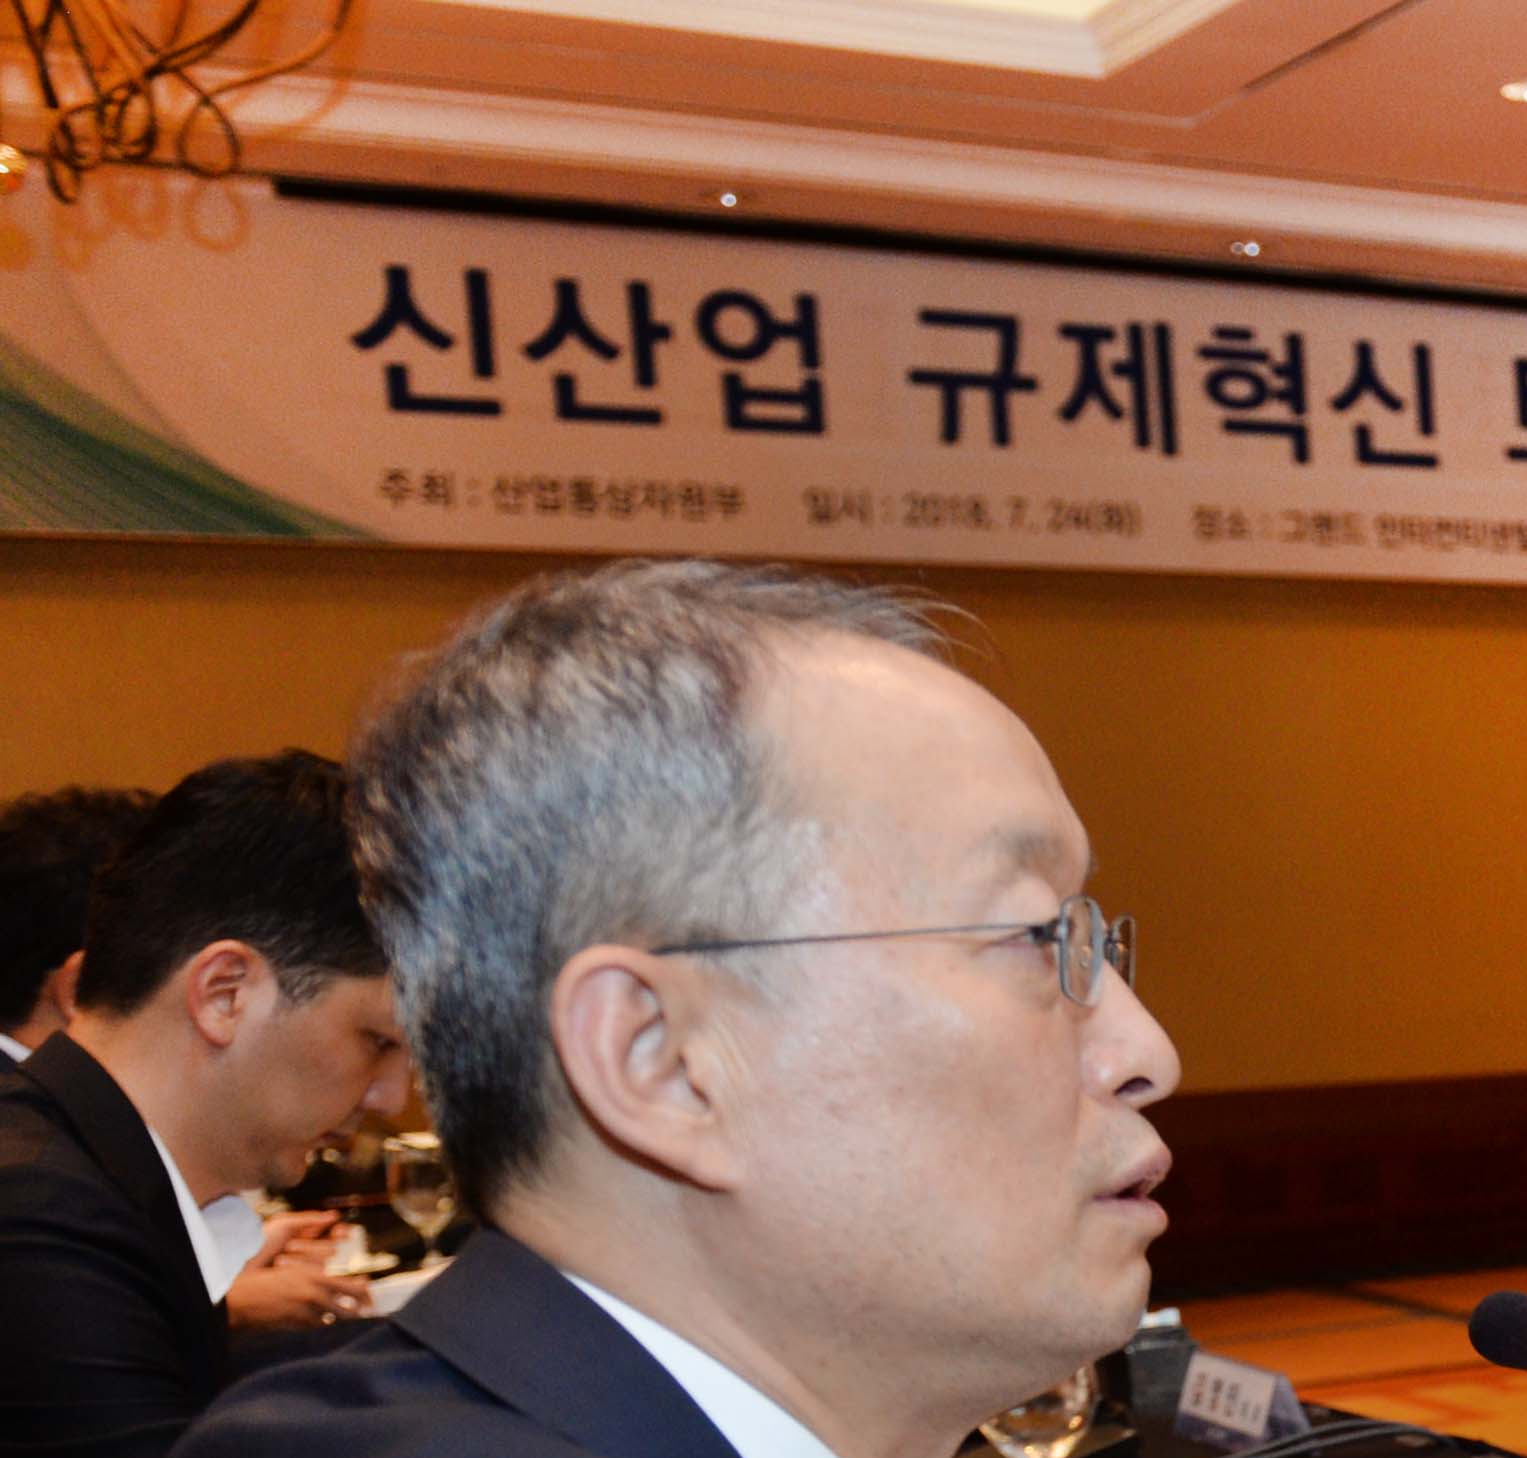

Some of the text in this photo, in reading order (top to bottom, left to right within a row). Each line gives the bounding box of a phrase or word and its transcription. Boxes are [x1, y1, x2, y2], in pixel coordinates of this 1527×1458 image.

[351, 263, 828, 438] 신산업
[906, 308, 1440, 470] 규제혁신
[380, 468, 453, 508] 주최
[804, 486, 874, 527] 일시
[1192, 506, 1247, 544] 장소
